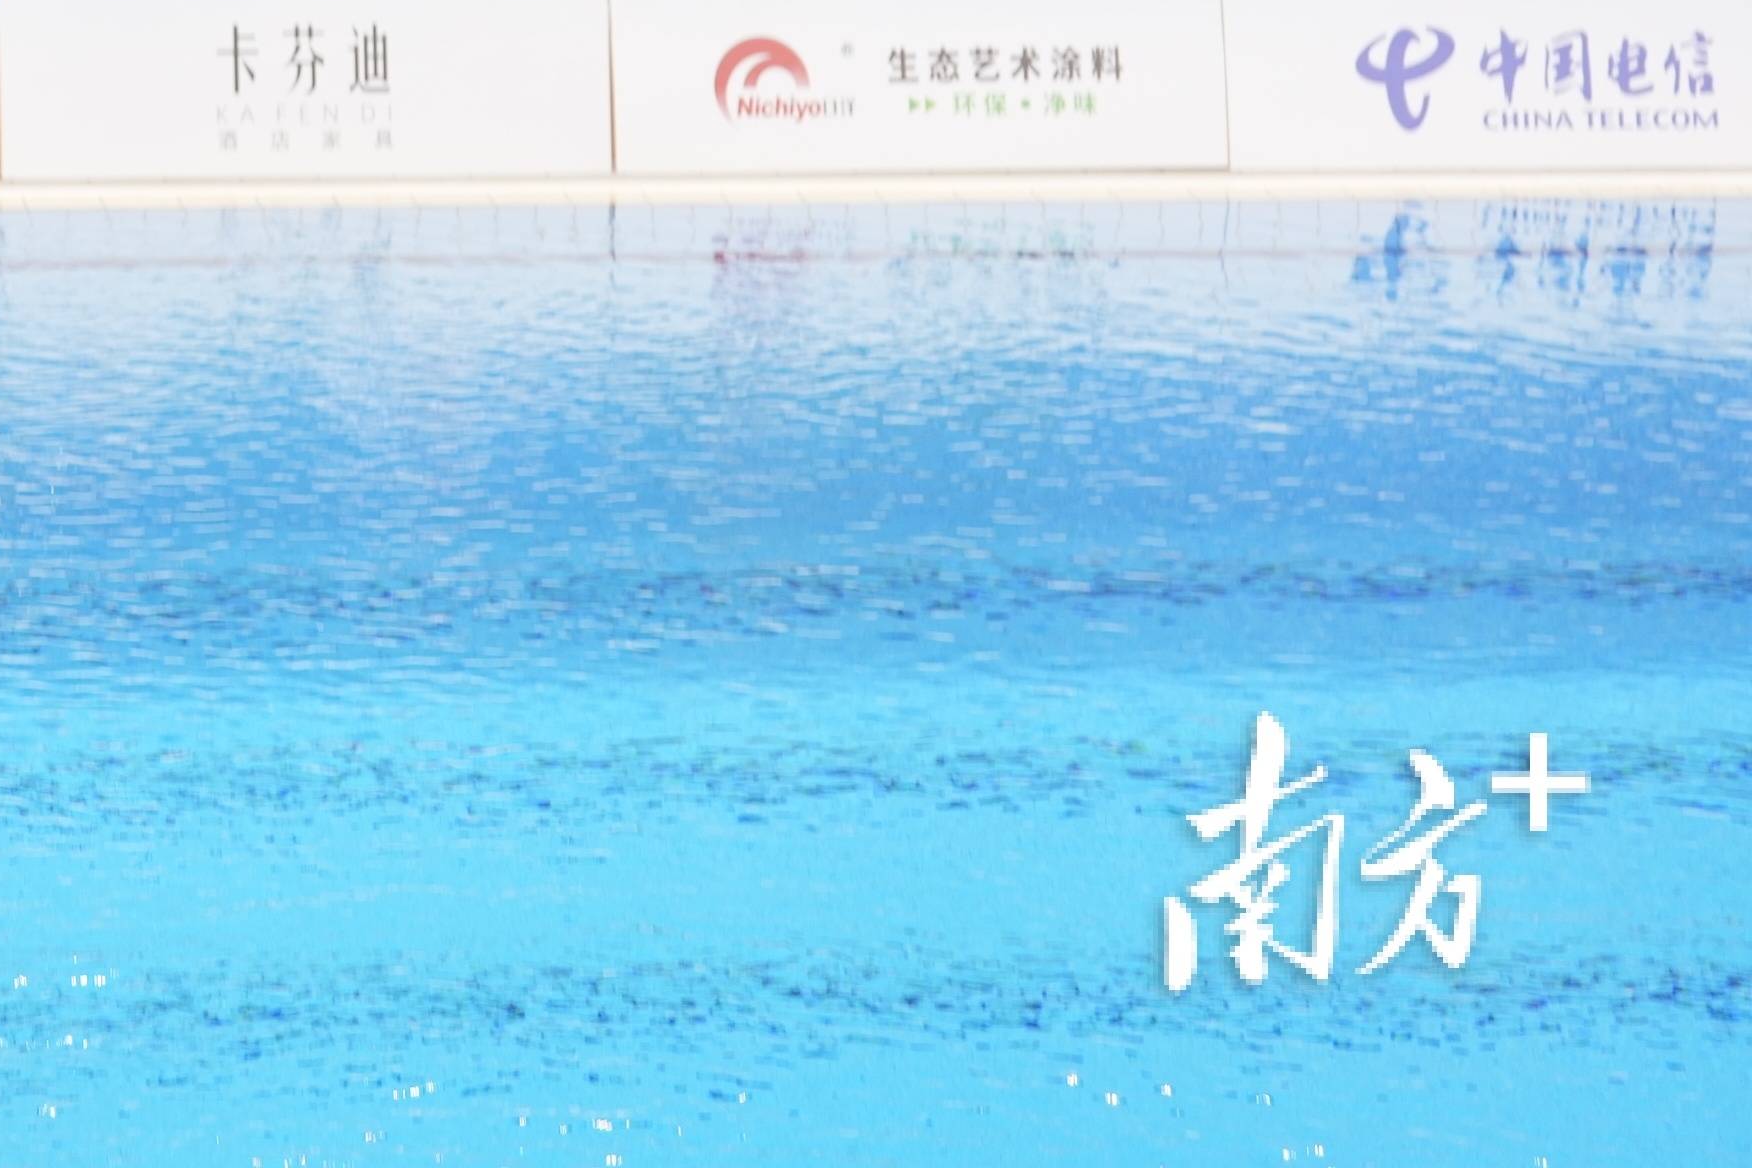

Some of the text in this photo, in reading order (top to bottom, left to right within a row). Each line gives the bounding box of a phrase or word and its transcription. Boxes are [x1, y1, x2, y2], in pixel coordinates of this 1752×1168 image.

[216, 22, 390, 94] 卡芬迪
[888, 44, 1124, 83] 生态艺术涂料
[1480, 27, 1715, 105] 中国电信
[1483, 107, 1720, 131] CHINA TELECOM
